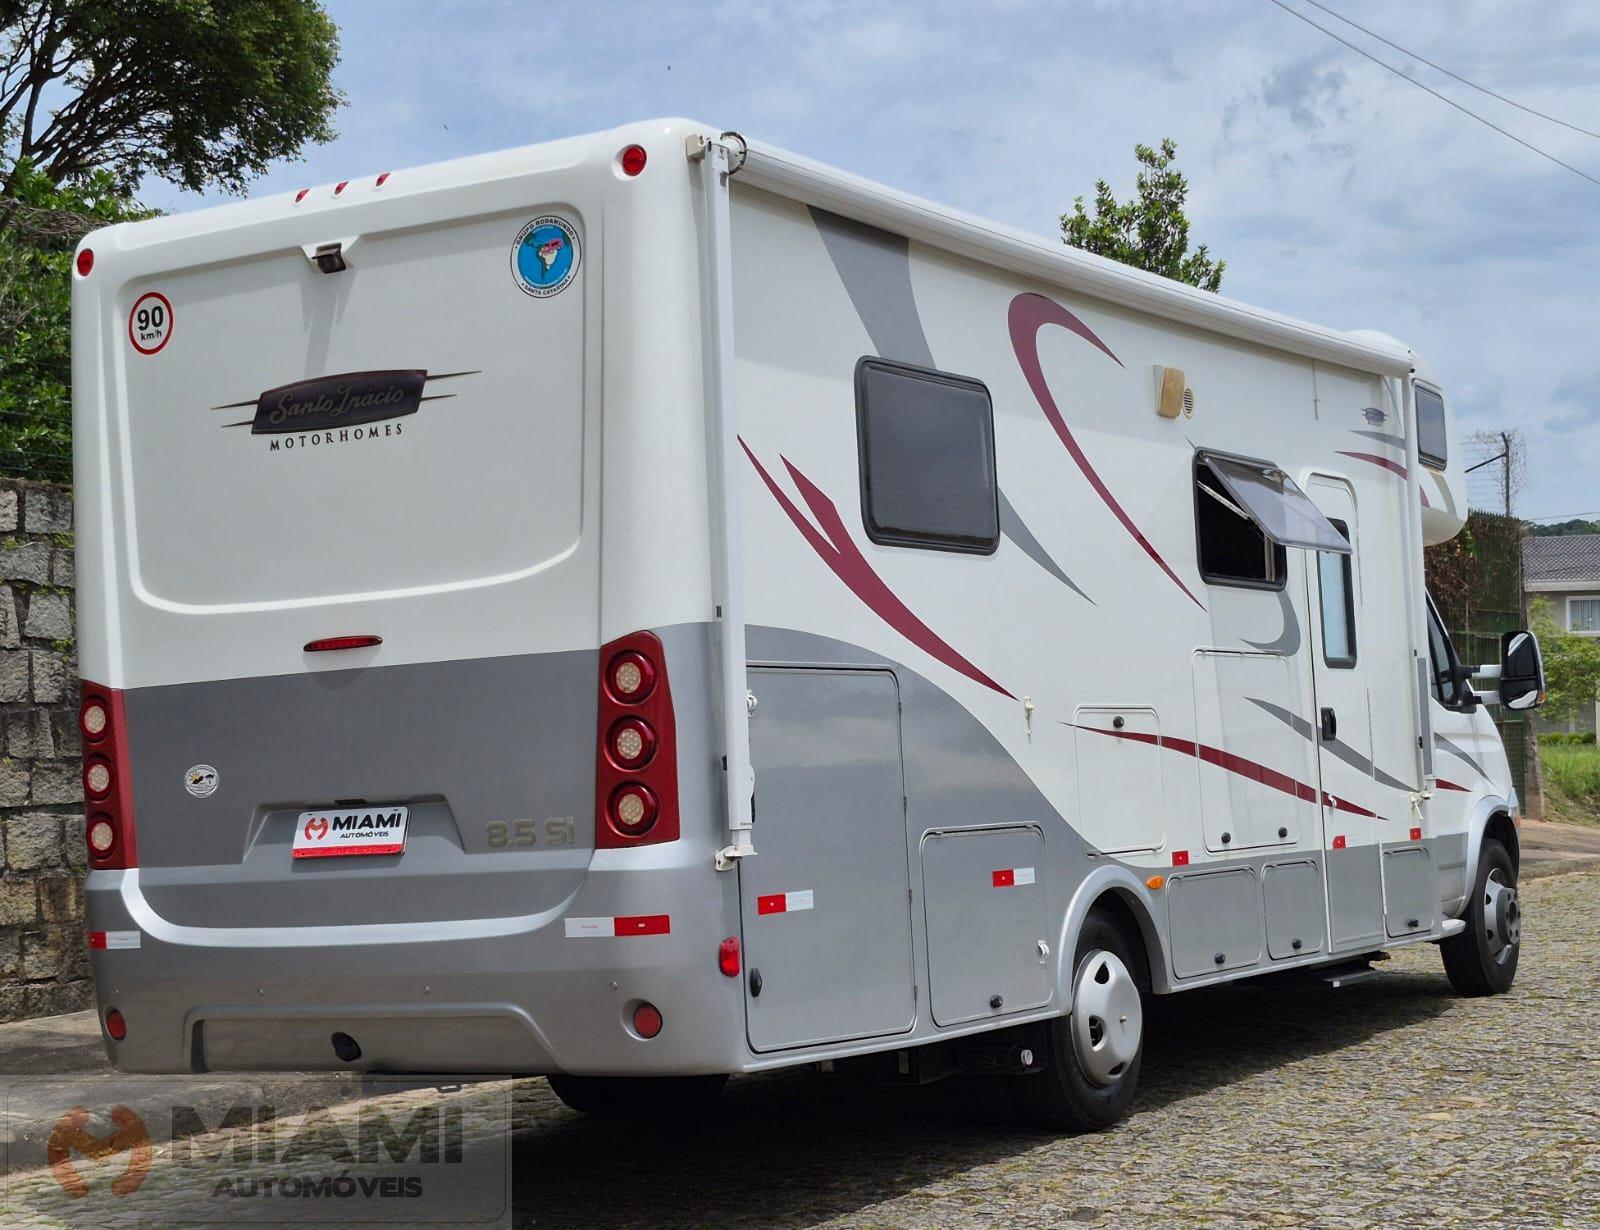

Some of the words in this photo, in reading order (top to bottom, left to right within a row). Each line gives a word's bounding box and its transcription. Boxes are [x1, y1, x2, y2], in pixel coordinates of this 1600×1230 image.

[516, 224, 535, 245] GRUPO
[524, 284, 542, 296] SANTA
[543, 278, 569, 296] CATARINA
[137, 305, 164, 332] 90
[140, 329, 162, 341] km/h
[269, 392, 334, 425] Santo
[330, 383, 404, 417] Inácio
[269, 423, 403, 451] MOTORHOMES
[332, 813, 402, 831] MIAMI
[340, 830, 389, 839] AUTOMÓVEIS
